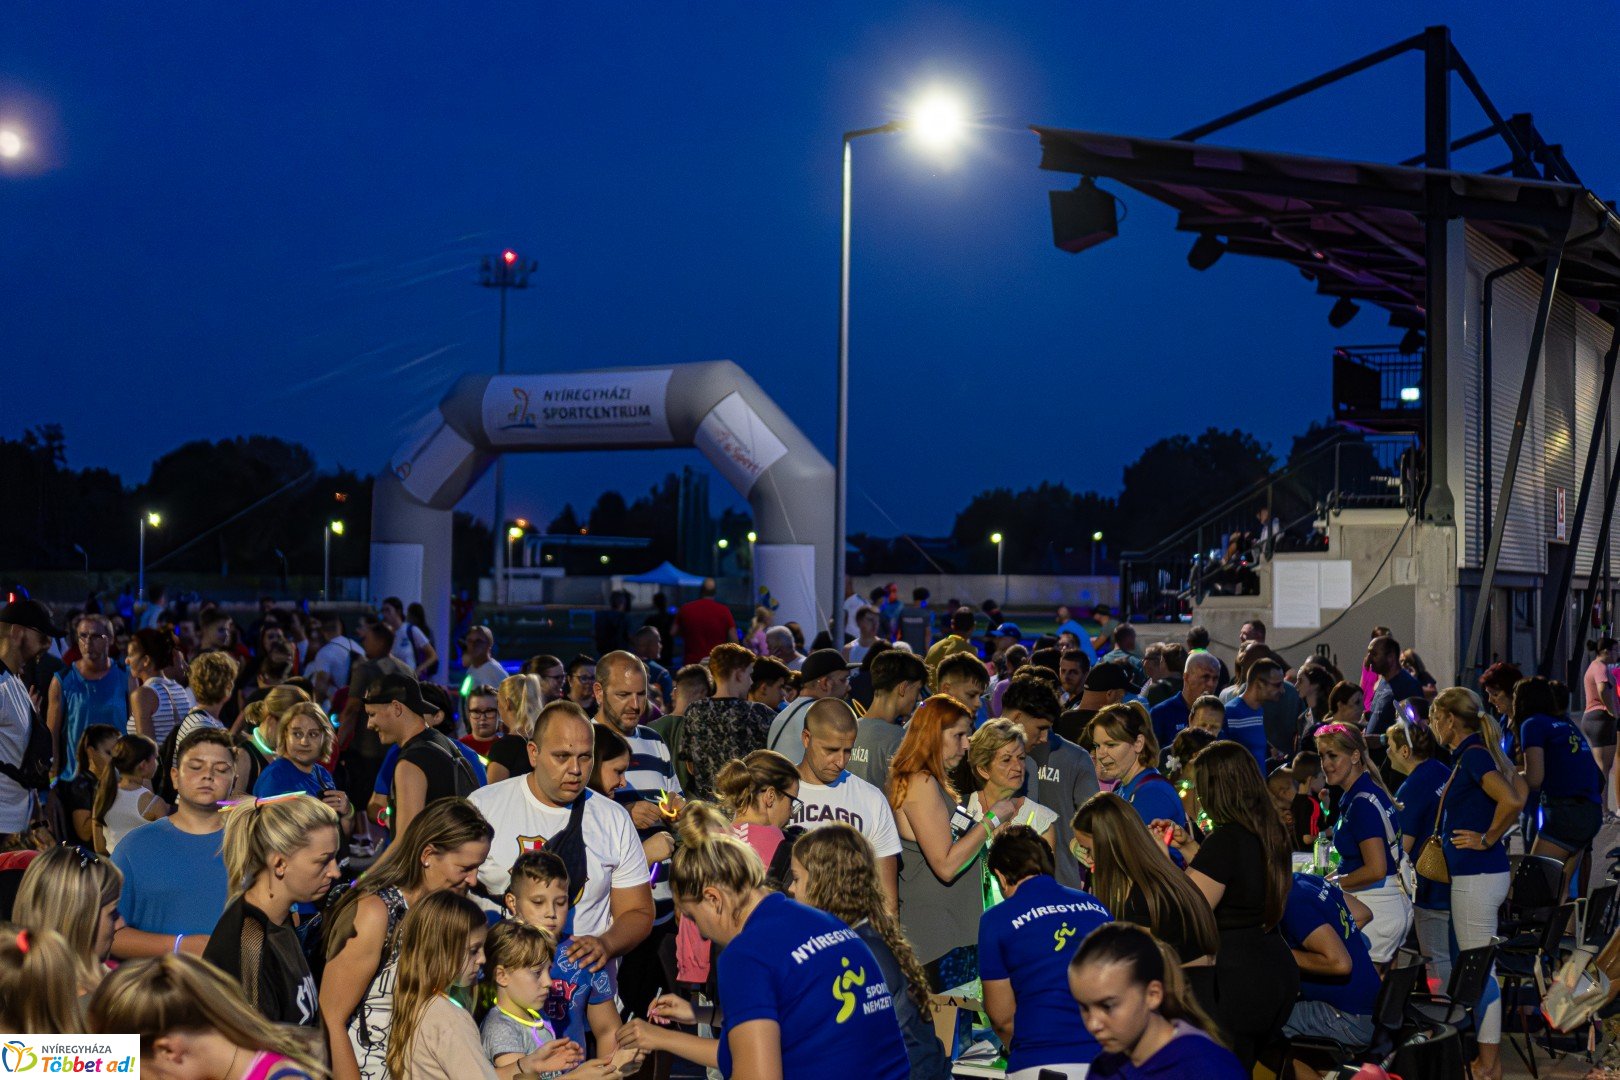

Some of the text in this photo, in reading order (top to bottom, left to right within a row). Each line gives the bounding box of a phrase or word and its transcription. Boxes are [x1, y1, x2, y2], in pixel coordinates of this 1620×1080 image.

[544, 386, 632, 400] NYÍREGYHÁZI
[542, 404, 651, 420] SPORTCENTRUM
[849, 746, 869, 763] HÁZA
[789, 803, 863, 833] HICAGO
[1011, 900, 1109, 930] NYÍREGYHÁZA
